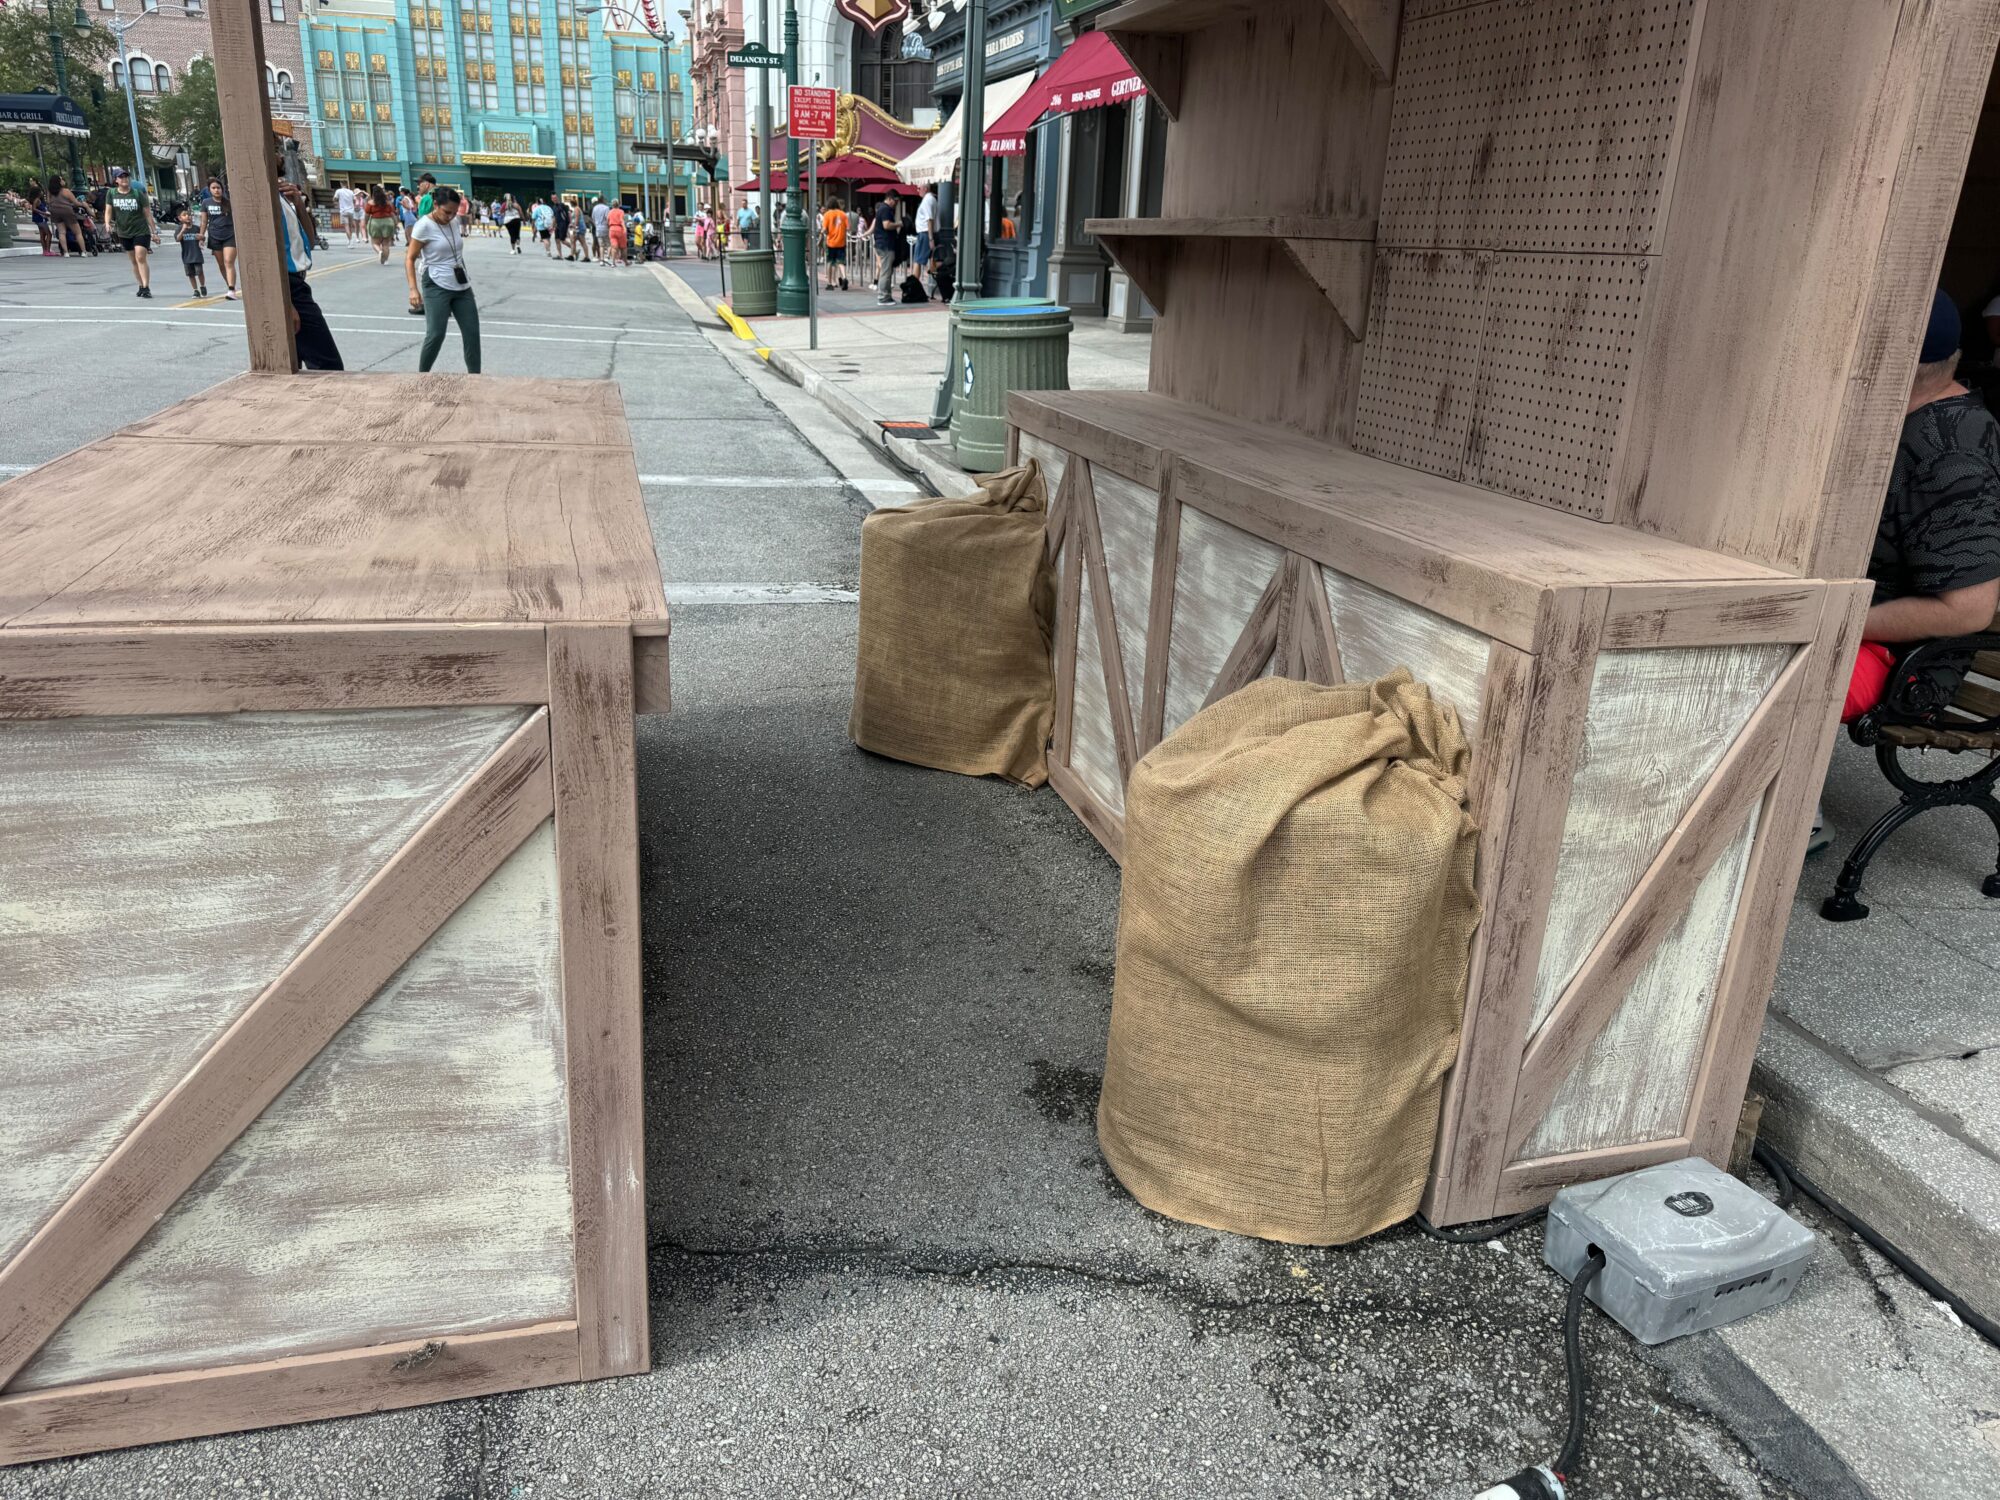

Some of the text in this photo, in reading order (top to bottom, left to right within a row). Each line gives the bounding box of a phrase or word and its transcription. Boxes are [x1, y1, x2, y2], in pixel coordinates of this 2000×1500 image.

[730, 55, 780, 65] DELANCEY ST.
[794, 88, 831, 97] NO STANDING
[821, 111, 831, 120] PM
[485, 139, 530, 154] TRIBUNE
